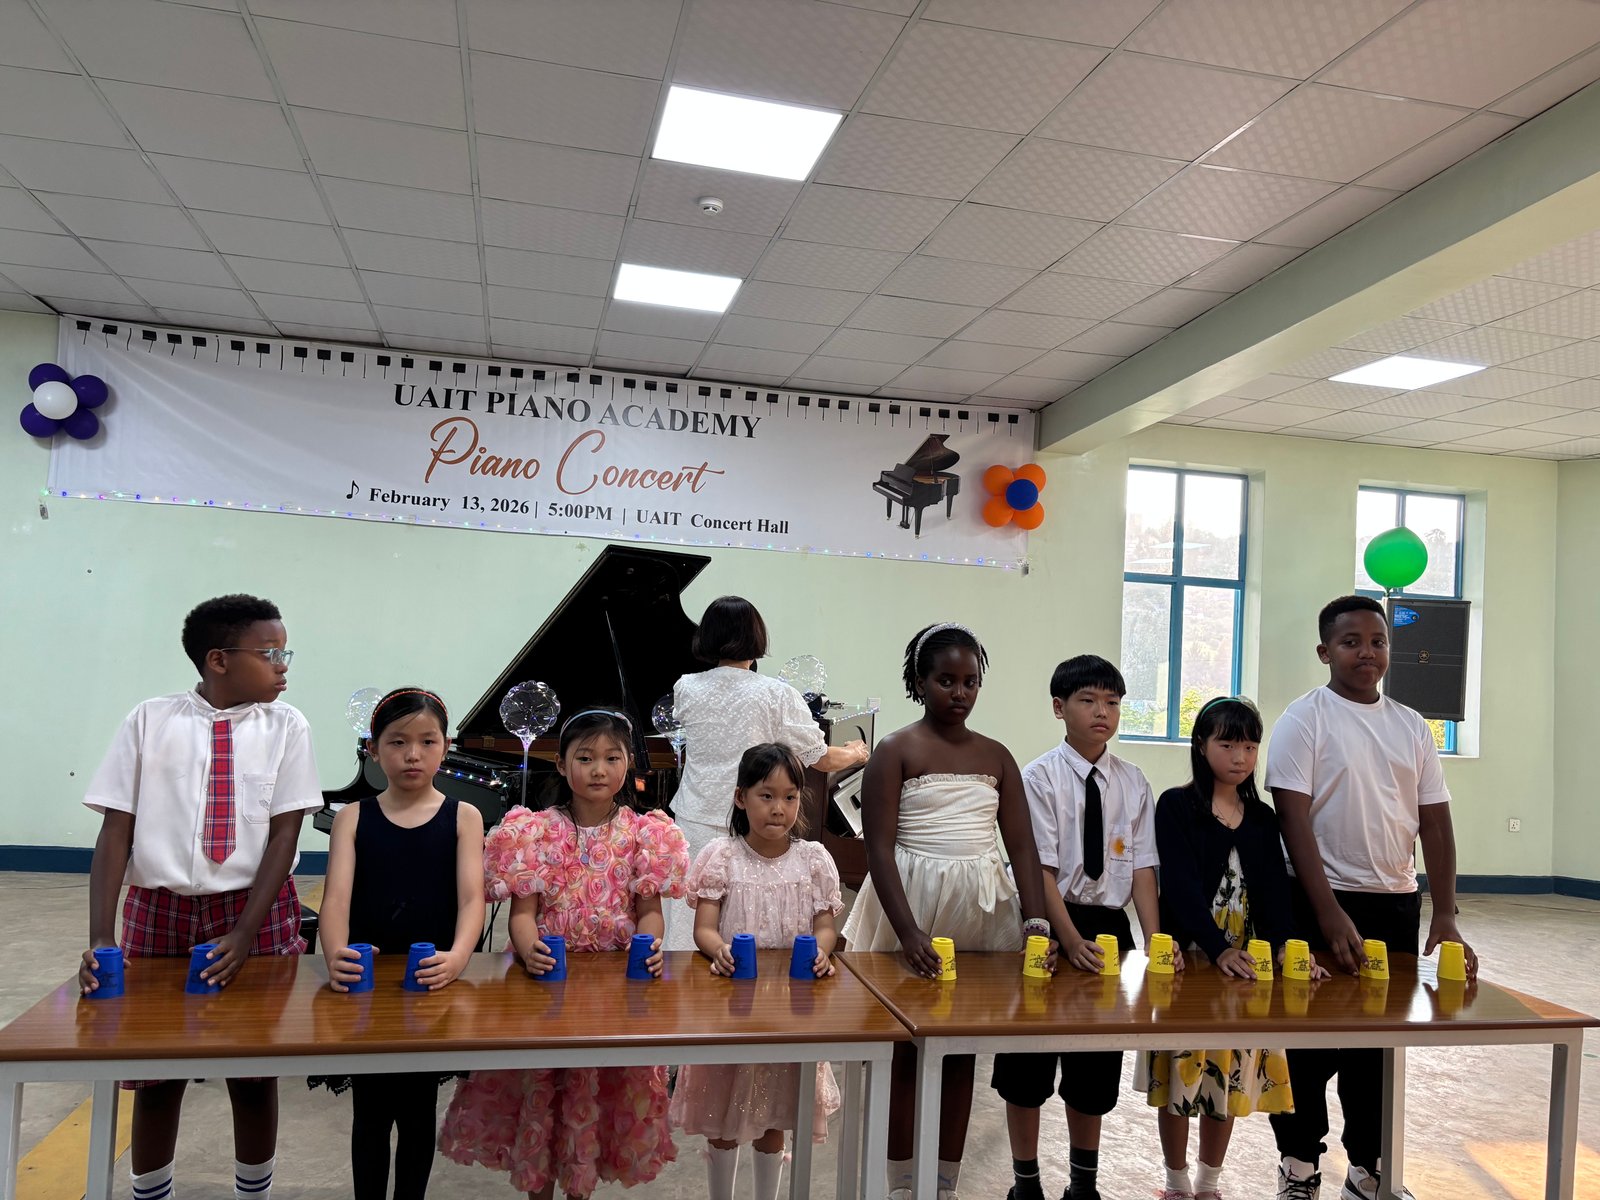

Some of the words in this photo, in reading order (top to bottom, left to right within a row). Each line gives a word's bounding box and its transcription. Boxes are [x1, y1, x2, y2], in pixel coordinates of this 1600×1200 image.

[394, 383, 477, 411] UAIT
[485, 391, 591, 422] PIANO
[598, 402, 762, 438] ACADEMY
[425, 416, 540, 483] Piano
[556, 429, 725, 495] Concert
[369, 487, 450, 511] February
[461, 495, 485, 513] 13,
[490, 498, 529, 514] 2026
[548, 502, 612, 520] 5:00PM
[636, 509, 682, 526] UAIT
[690, 513, 752, 532] Concert
[757, 518, 789, 534] Hall
